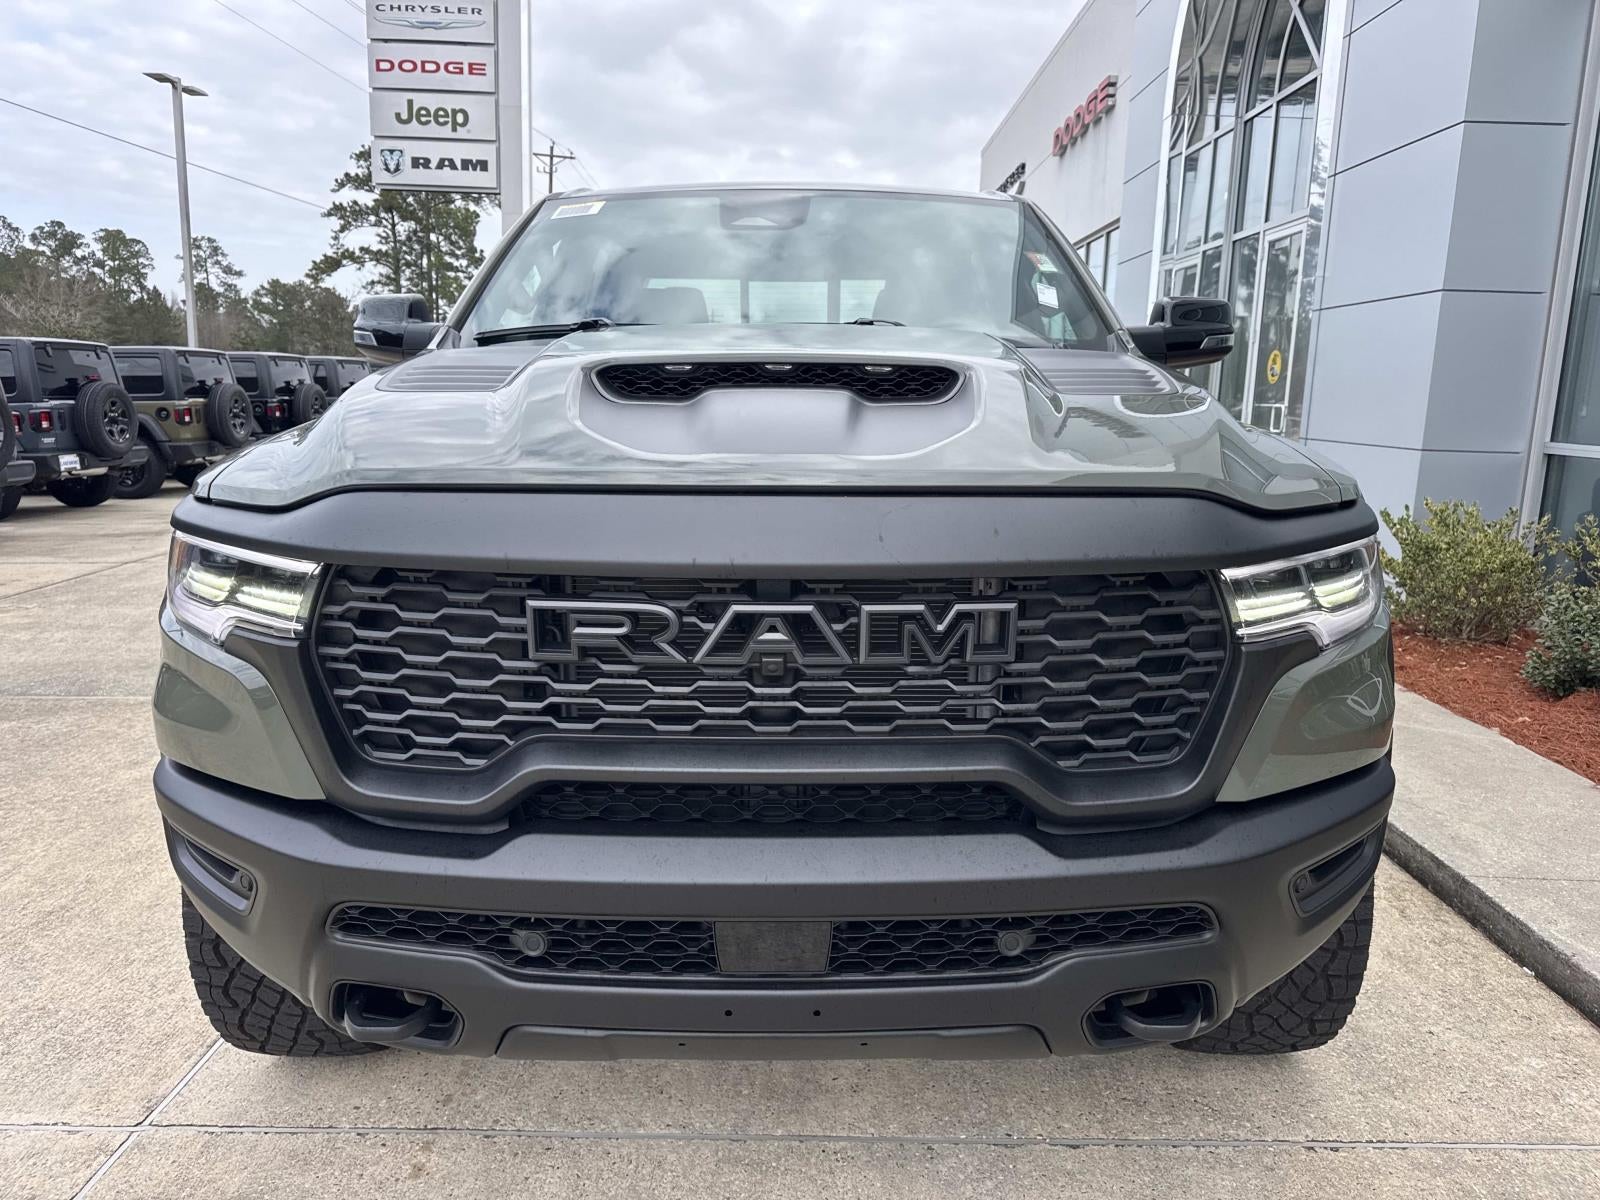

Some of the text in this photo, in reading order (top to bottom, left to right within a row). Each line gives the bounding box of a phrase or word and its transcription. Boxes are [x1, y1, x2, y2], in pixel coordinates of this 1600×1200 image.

[375, 4, 483, 16] CHRYSLER
[375, 58, 487, 76] DODGE
[394, 99, 469, 133] Jeep
[1052, 75, 1119, 157] DODGE
[410, 156, 489, 172] RAM
[525, 599, 1019, 665] RAM
